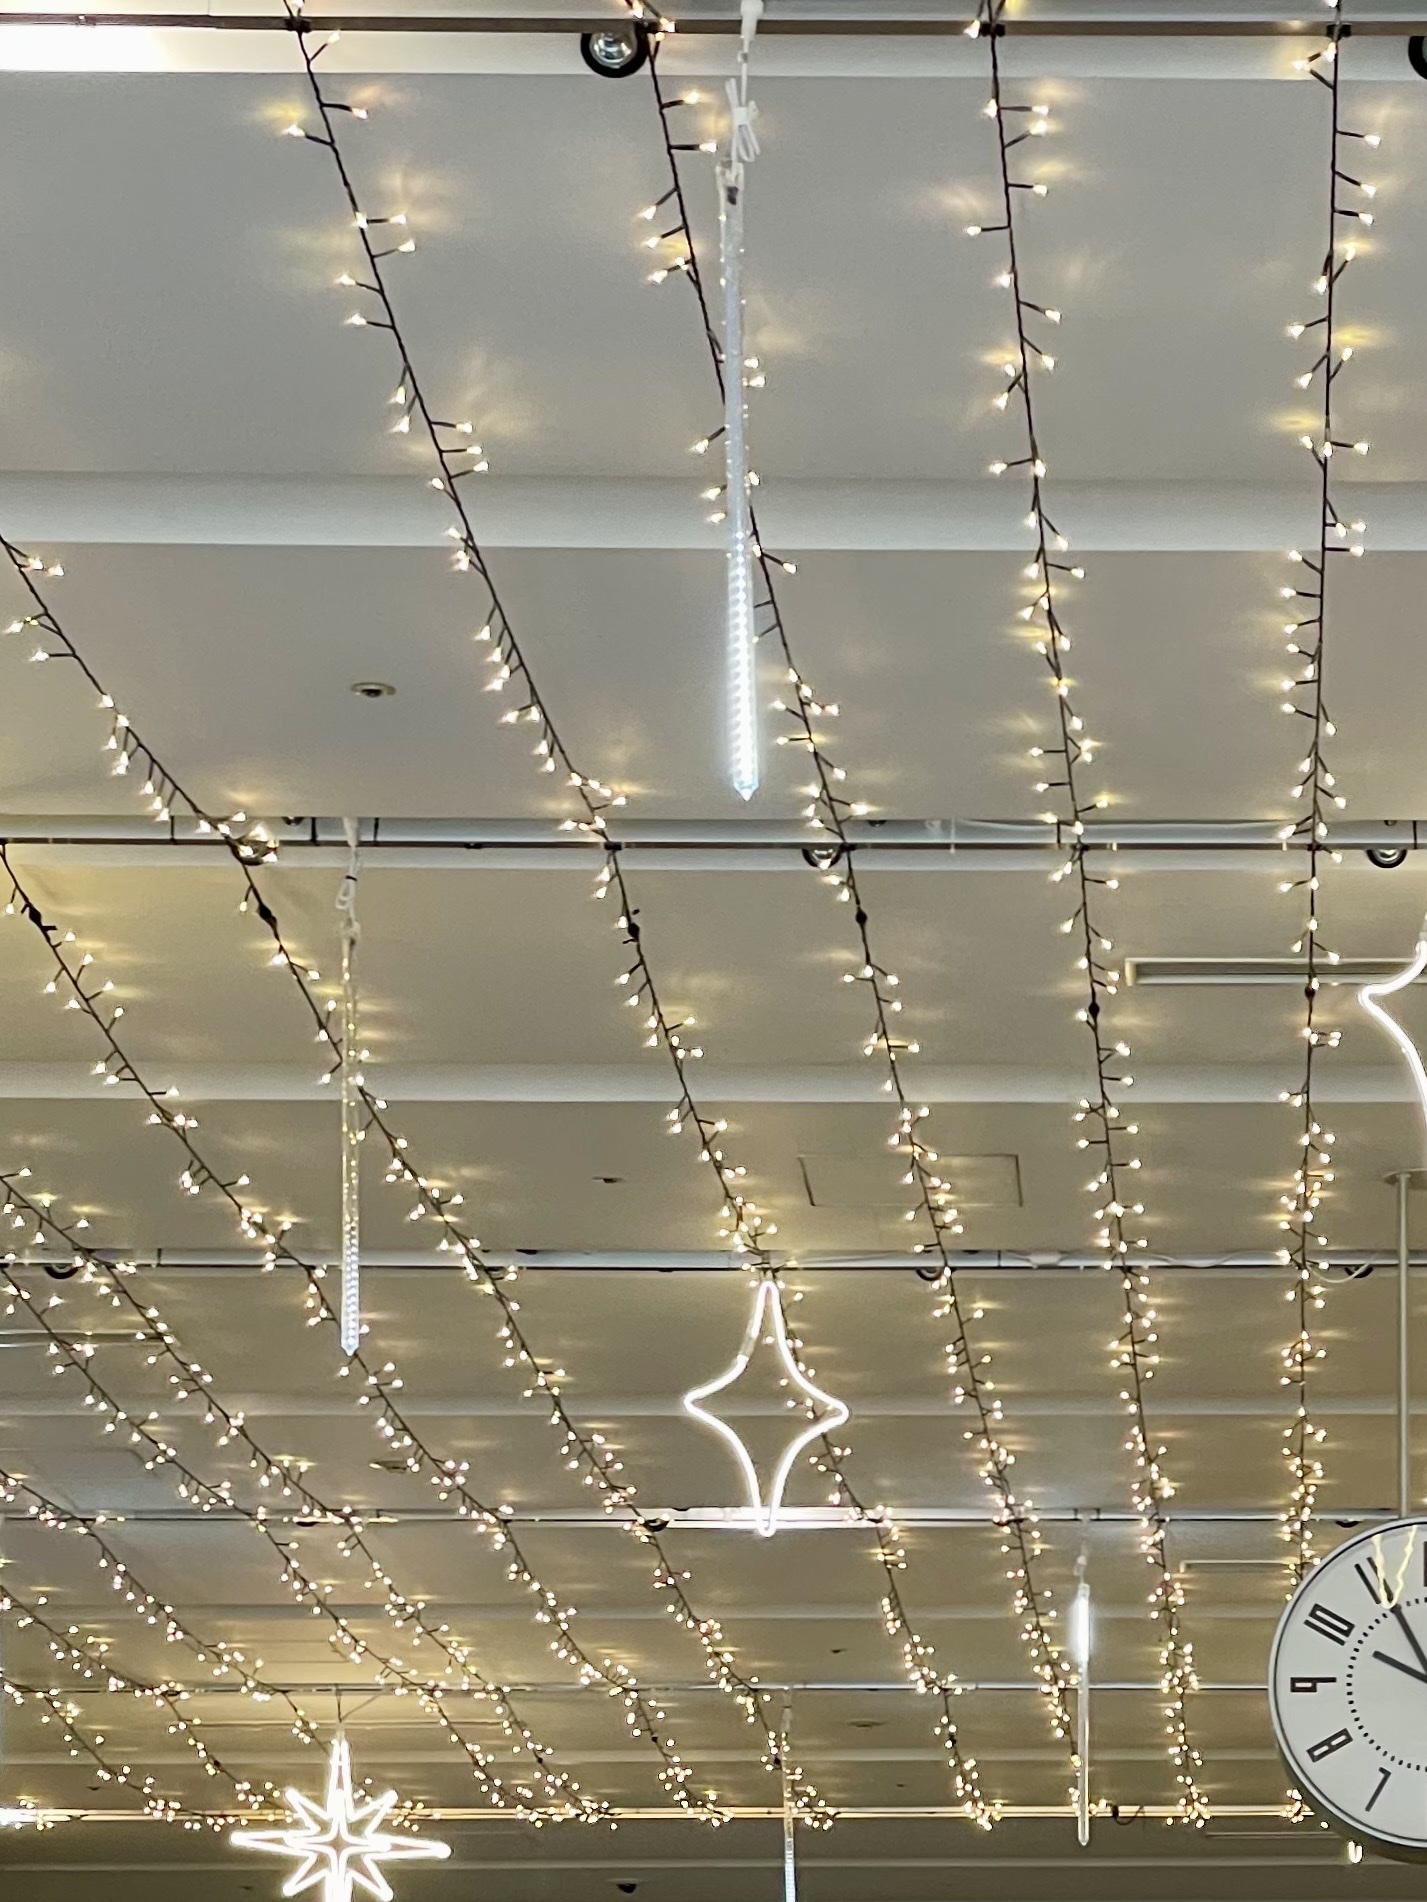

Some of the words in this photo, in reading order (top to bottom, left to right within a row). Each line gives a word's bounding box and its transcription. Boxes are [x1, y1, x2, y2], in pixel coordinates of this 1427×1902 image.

[1303, 1603, 1356, 1646] 10
[1290, 1676, 1337, 1693] 9
[1306, 1728, 1353, 1763] 8
[1365, 1767, 1392, 1812] 7
